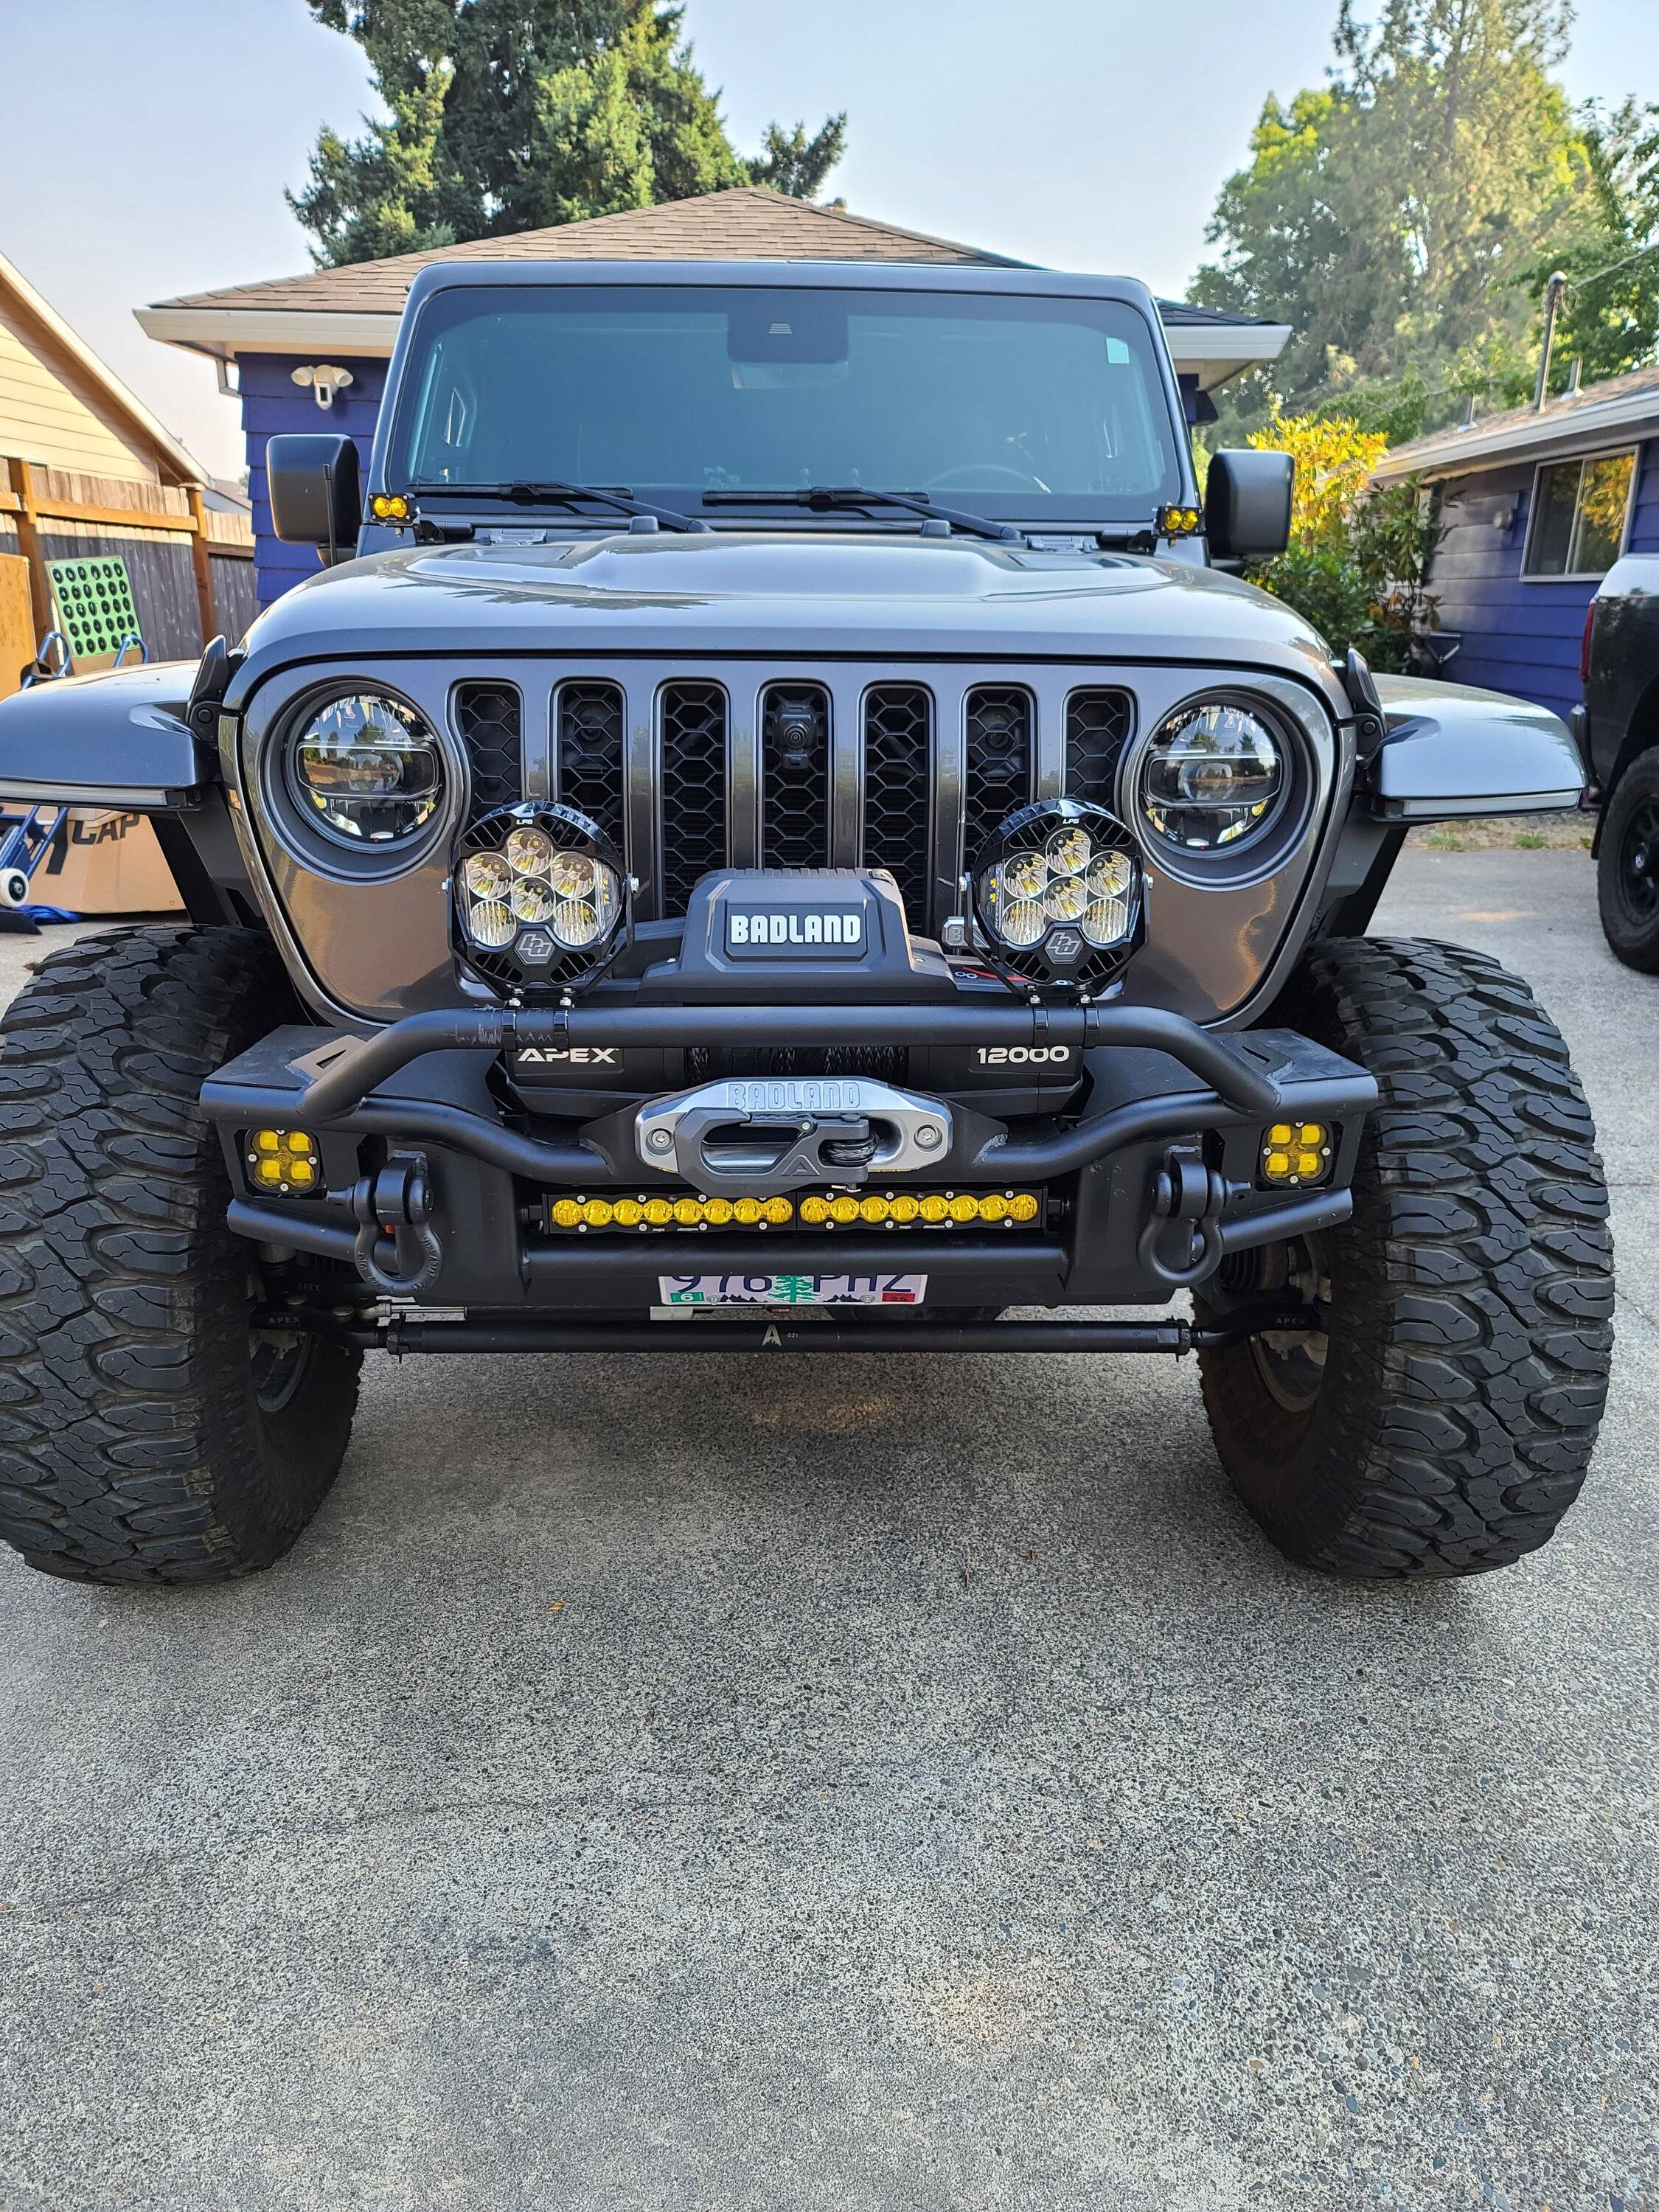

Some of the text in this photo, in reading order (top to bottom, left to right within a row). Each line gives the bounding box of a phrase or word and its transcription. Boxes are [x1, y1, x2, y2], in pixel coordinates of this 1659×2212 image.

[731, 915, 860, 944] BADLAND
[518, 1048, 616, 1063] APEX
[977, 1046, 1069, 1064] 12000
[728, 1082, 860, 1110] BADLAND
[680, 1293, 694, 1301] 6
